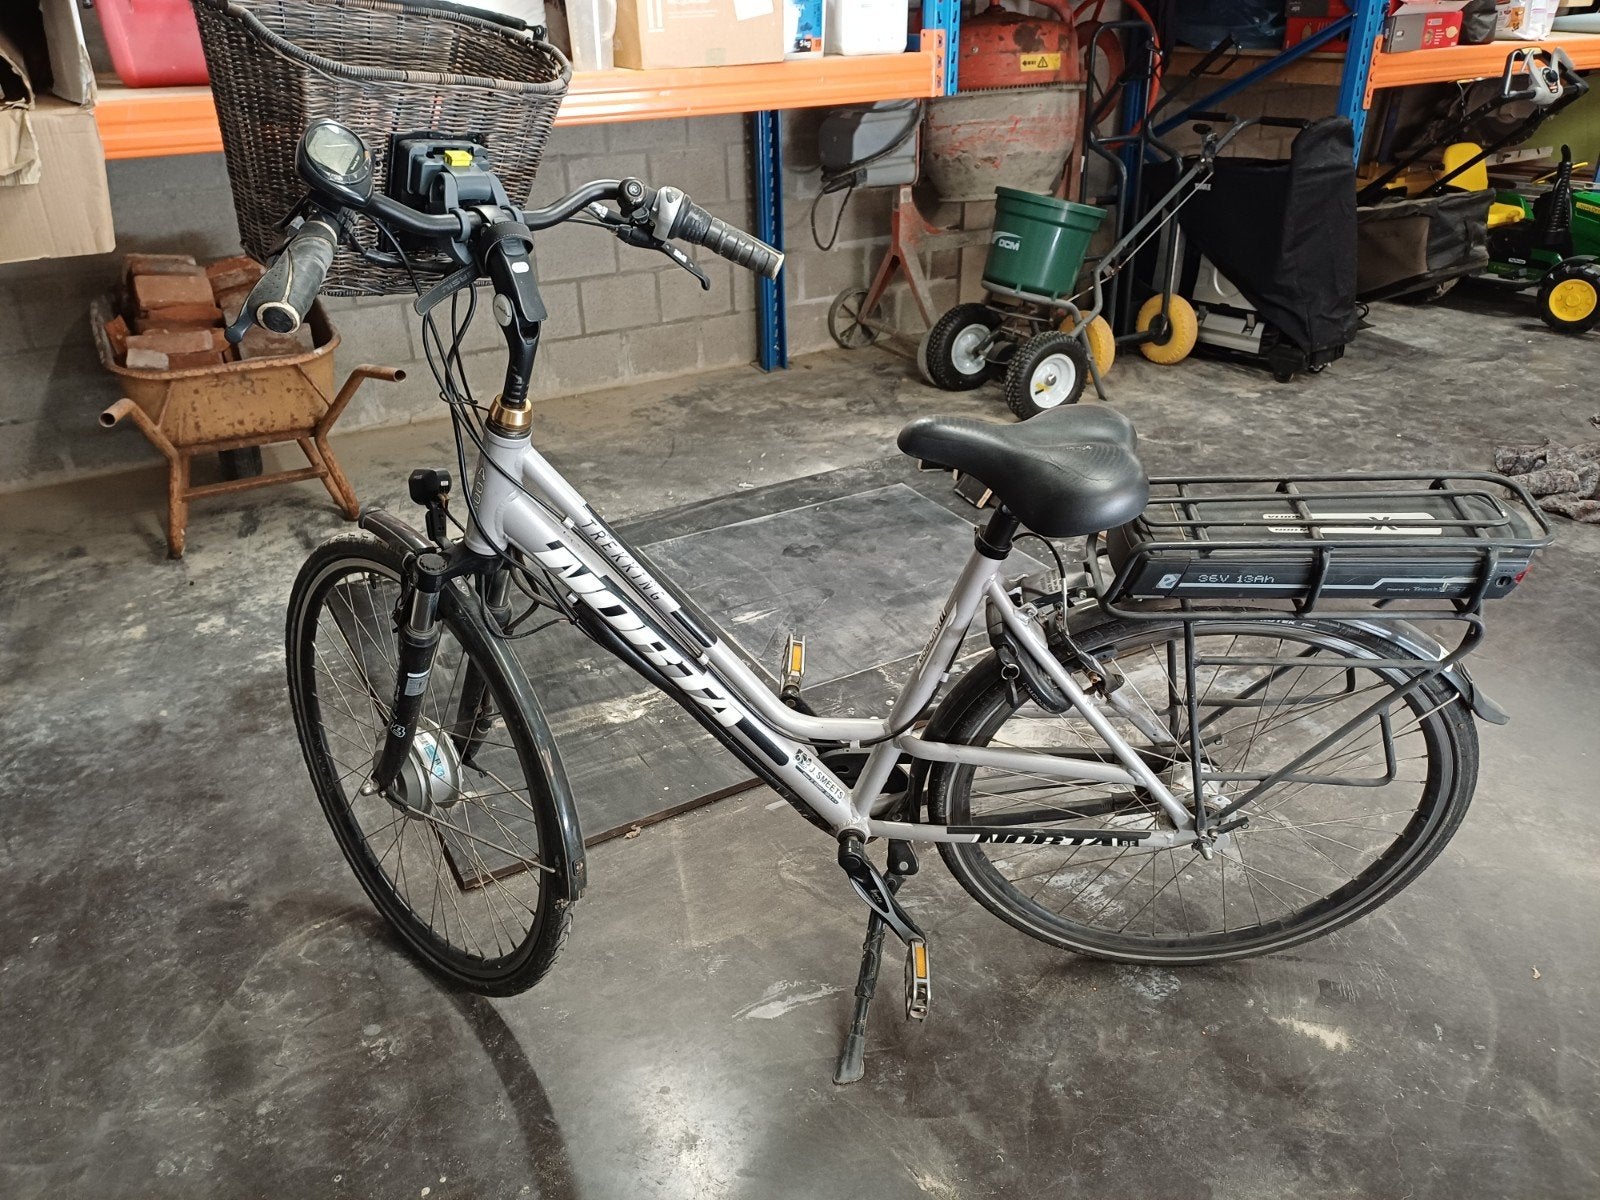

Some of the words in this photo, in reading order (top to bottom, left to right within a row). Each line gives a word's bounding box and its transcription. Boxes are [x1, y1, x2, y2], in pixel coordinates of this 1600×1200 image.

[581, 519, 665, 601] TREKKING
[1198, 574, 1230, 584] 36V
[1236, 574, 1275, 584] 13Ah
[534, 540, 744, 728] NORTA
[816, 771, 844, 800] SMEETS
